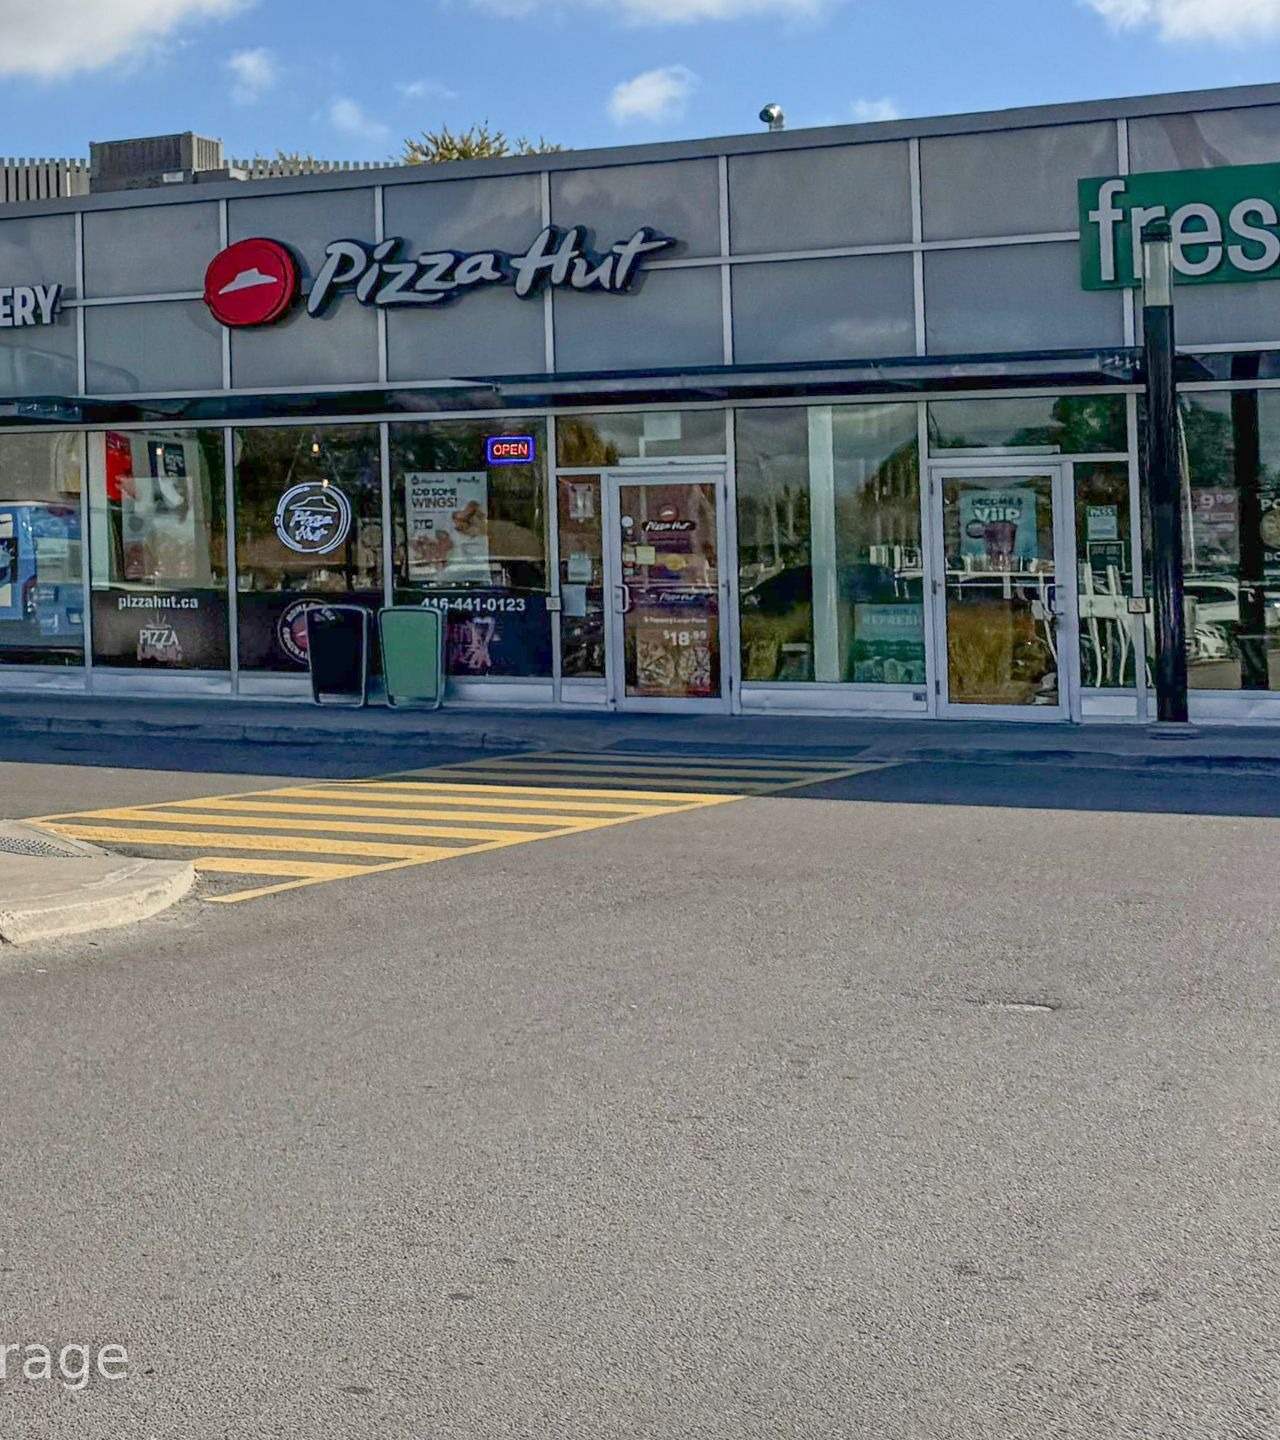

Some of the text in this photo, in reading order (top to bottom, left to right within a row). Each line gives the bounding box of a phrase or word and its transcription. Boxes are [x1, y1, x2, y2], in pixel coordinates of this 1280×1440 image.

[307, 226, 676, 316] Pizza Hut
[492, 444, 529, 456] OPEN
[431, 487, 457, 497] SOME
[411, 497, 458, 509] WINGS!
[289, 510, 334, 527] Pizza
[118, 594, 199, 611] pizzahut.ca
[139, 629, 179, 647] PIZZA
